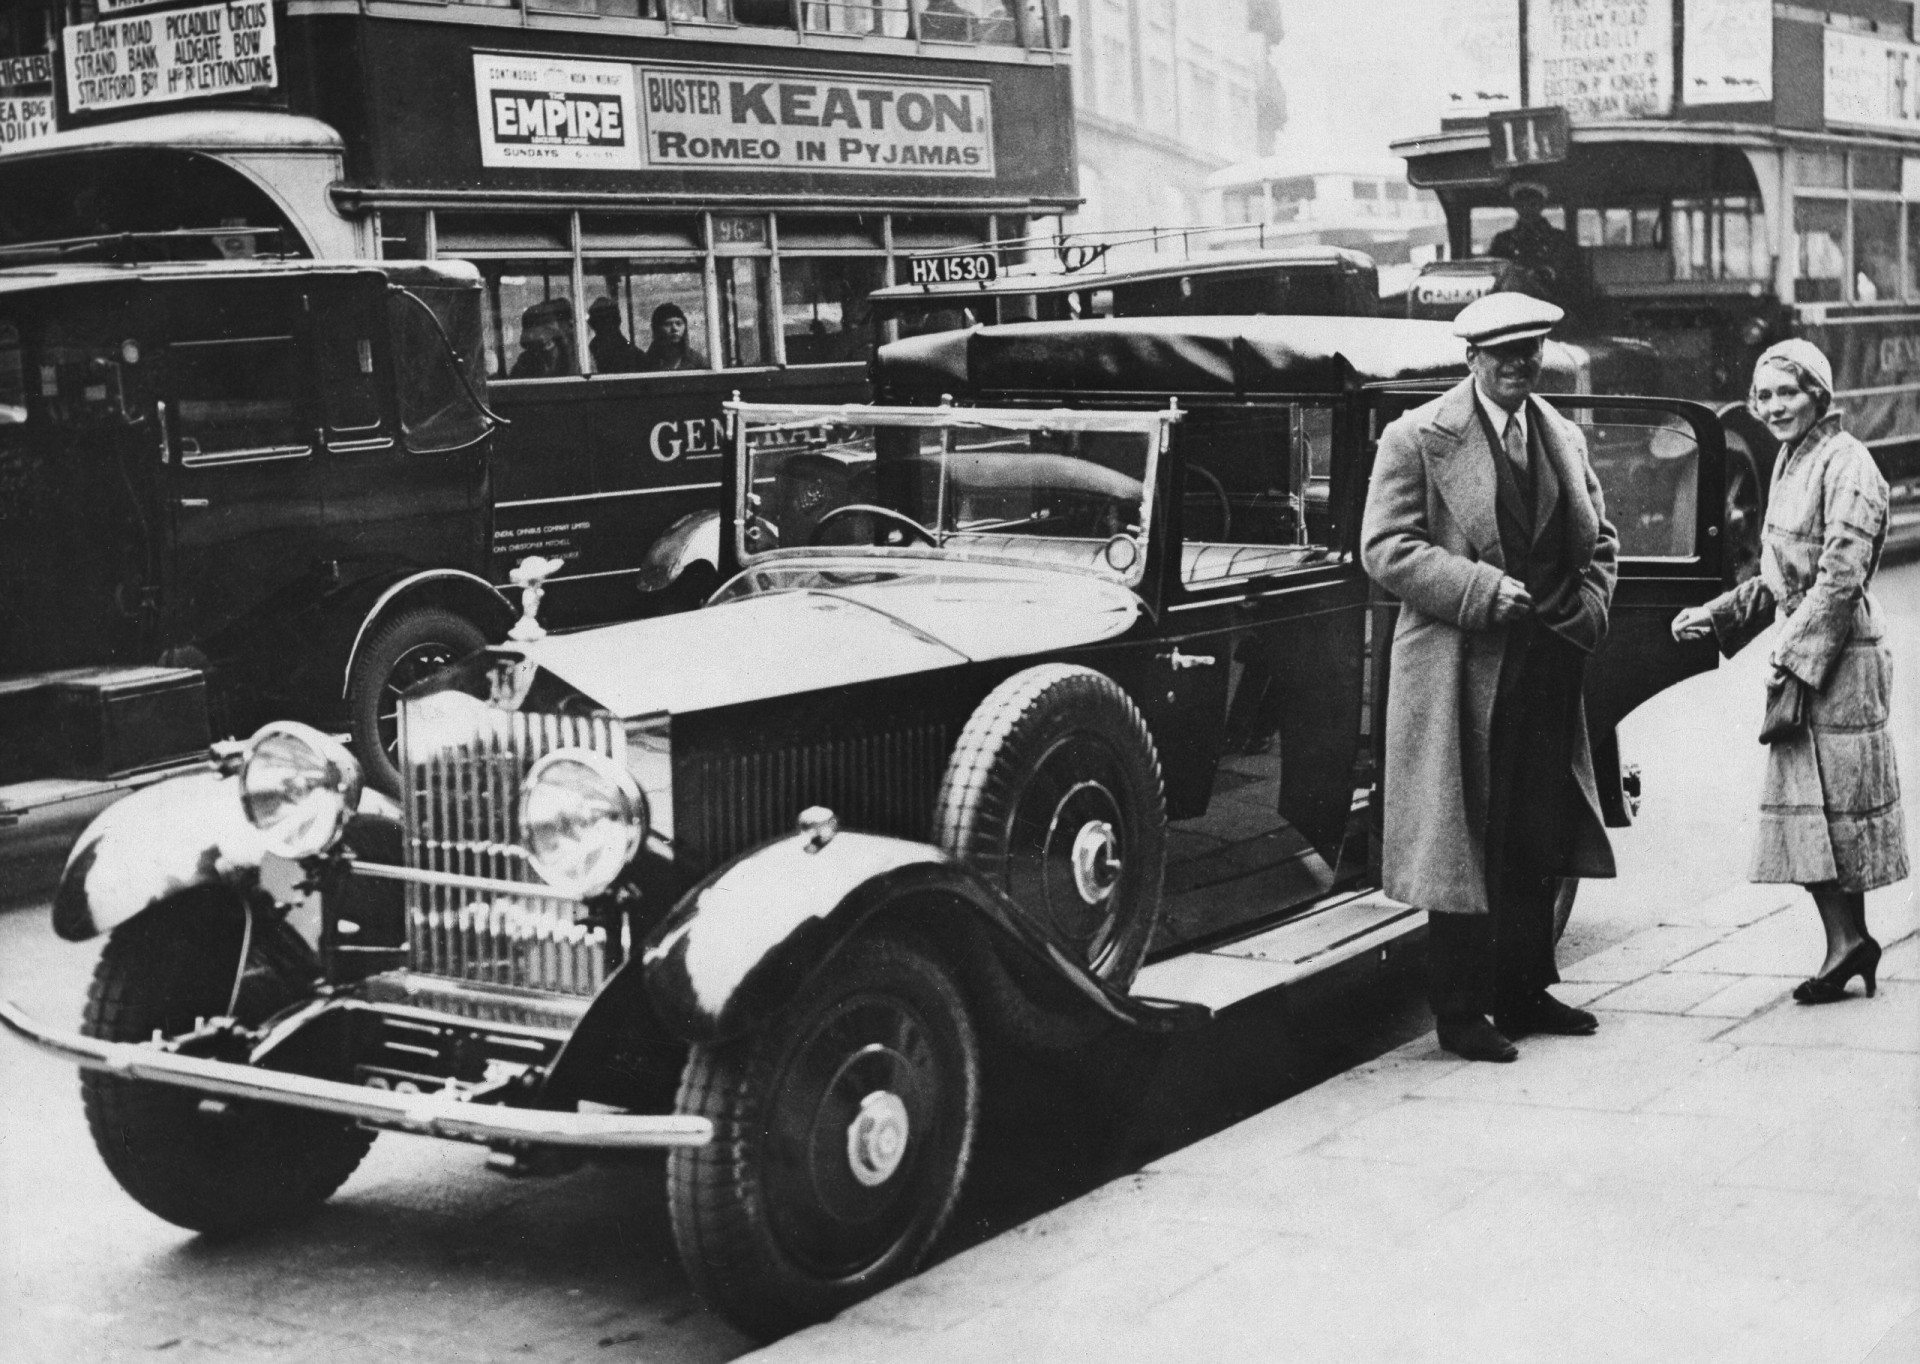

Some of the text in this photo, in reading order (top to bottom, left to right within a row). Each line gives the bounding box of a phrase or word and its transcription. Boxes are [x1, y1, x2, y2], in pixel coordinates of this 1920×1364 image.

[76, 3, 267, 54] FULHAM ROAD PICCADILLY CIRCUS
[75, 30, 261, 80] STRAND BANK ALDGATE BOW
[78, 74, 136, 105] STRATFORD
[198, 55, 272, 89] LEYTONSTONE
[648, 76, 722, 116] BUSTER
[494, 96, 622, 140] EMPIRE
[503, 148, 559, 158] SUNDAYS
[795, 140, 827, 162] IN
[912, 256, 990, 282] HX 1530
[545, 539, 570, 547] MITCHELL
